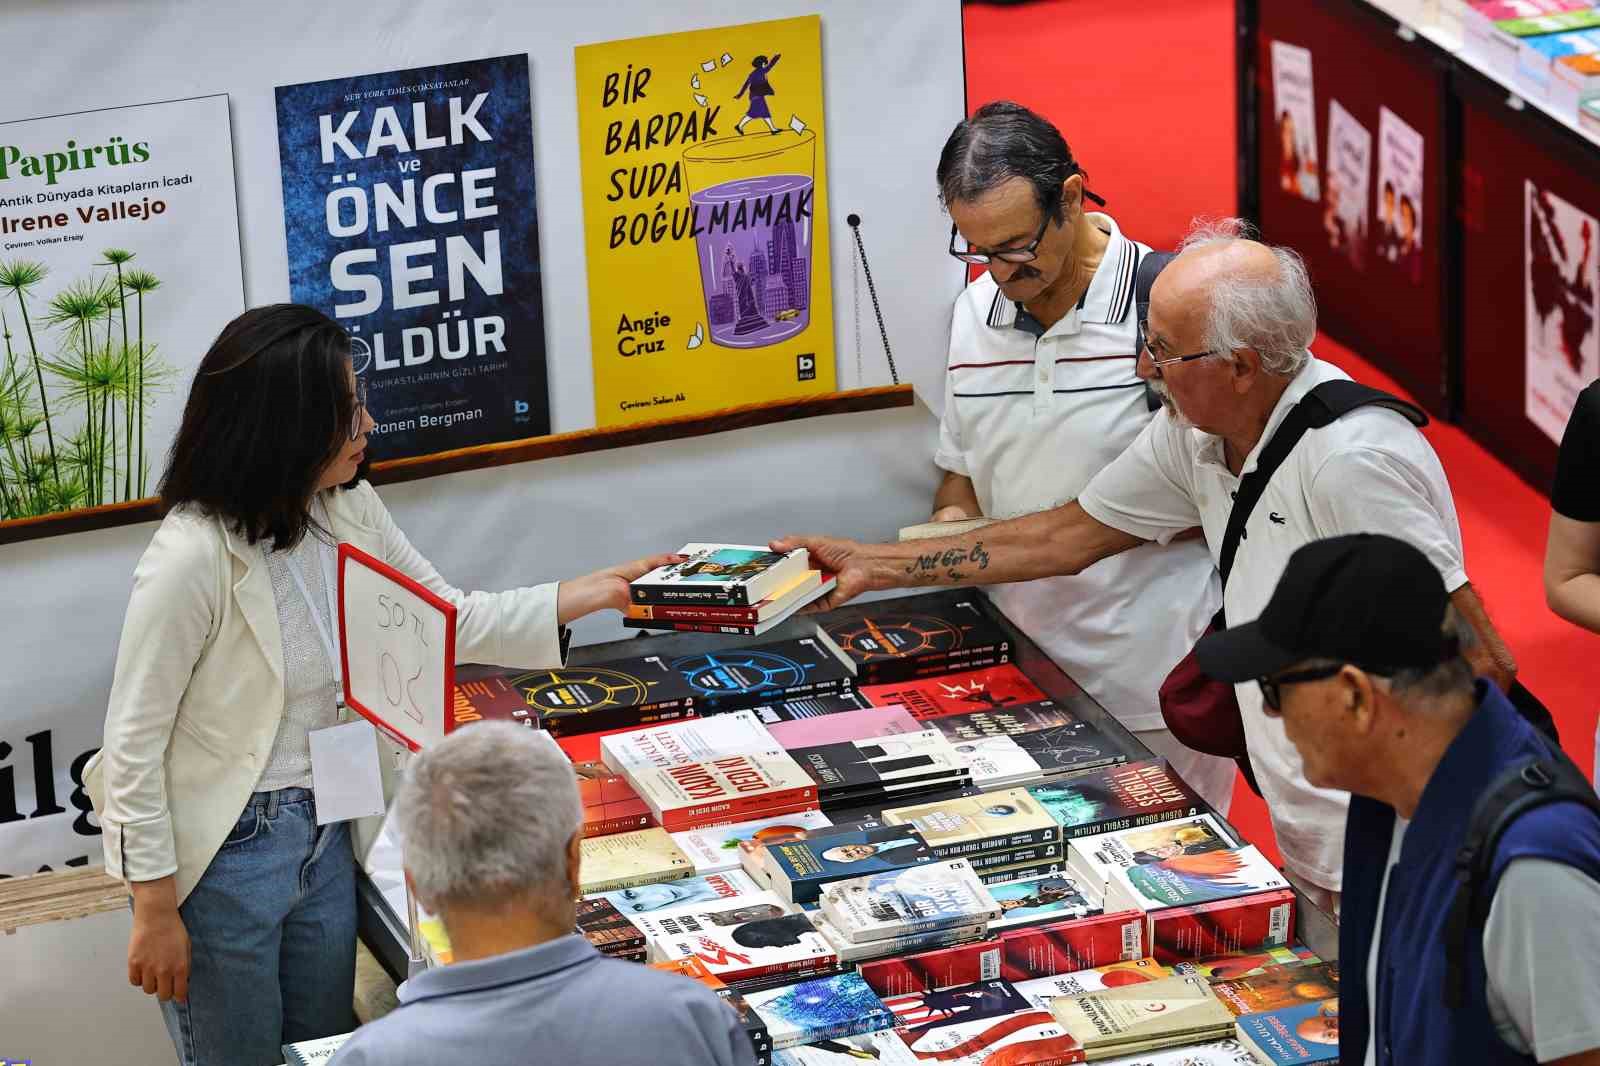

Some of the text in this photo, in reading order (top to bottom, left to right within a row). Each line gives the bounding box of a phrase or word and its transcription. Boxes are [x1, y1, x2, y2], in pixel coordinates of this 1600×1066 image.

[364, 90, 385, 99] YORK
[602, 64, 652, 108] BİR
[319, 92, 493, 164] KALK
[605, 105, 721, 155] BARDAK
[0, 136, 150, 185] Papirüs
[398, 158, 421, 172] ve
[0, 174, 193, 208] Antik Dünyada Kitapların İcadı
[607, 161, 682, 202] SUDA
[2, 197, 167, 234] Irene Vallejo
[326, 167, 499, 238] ÖNCE
[610, 187, 814, 250] BOĞULMAMAK
[329, 229, 504, 318] SEN
[617, 311, 672, 335] Angie
[618, 336, 665, 358] Cruz
[371, 408, 483, 436] Ronen Bergman
[667, 764, 727, 799] KADIN
[1114, 770, 1163, 807] SEVGİLİ
